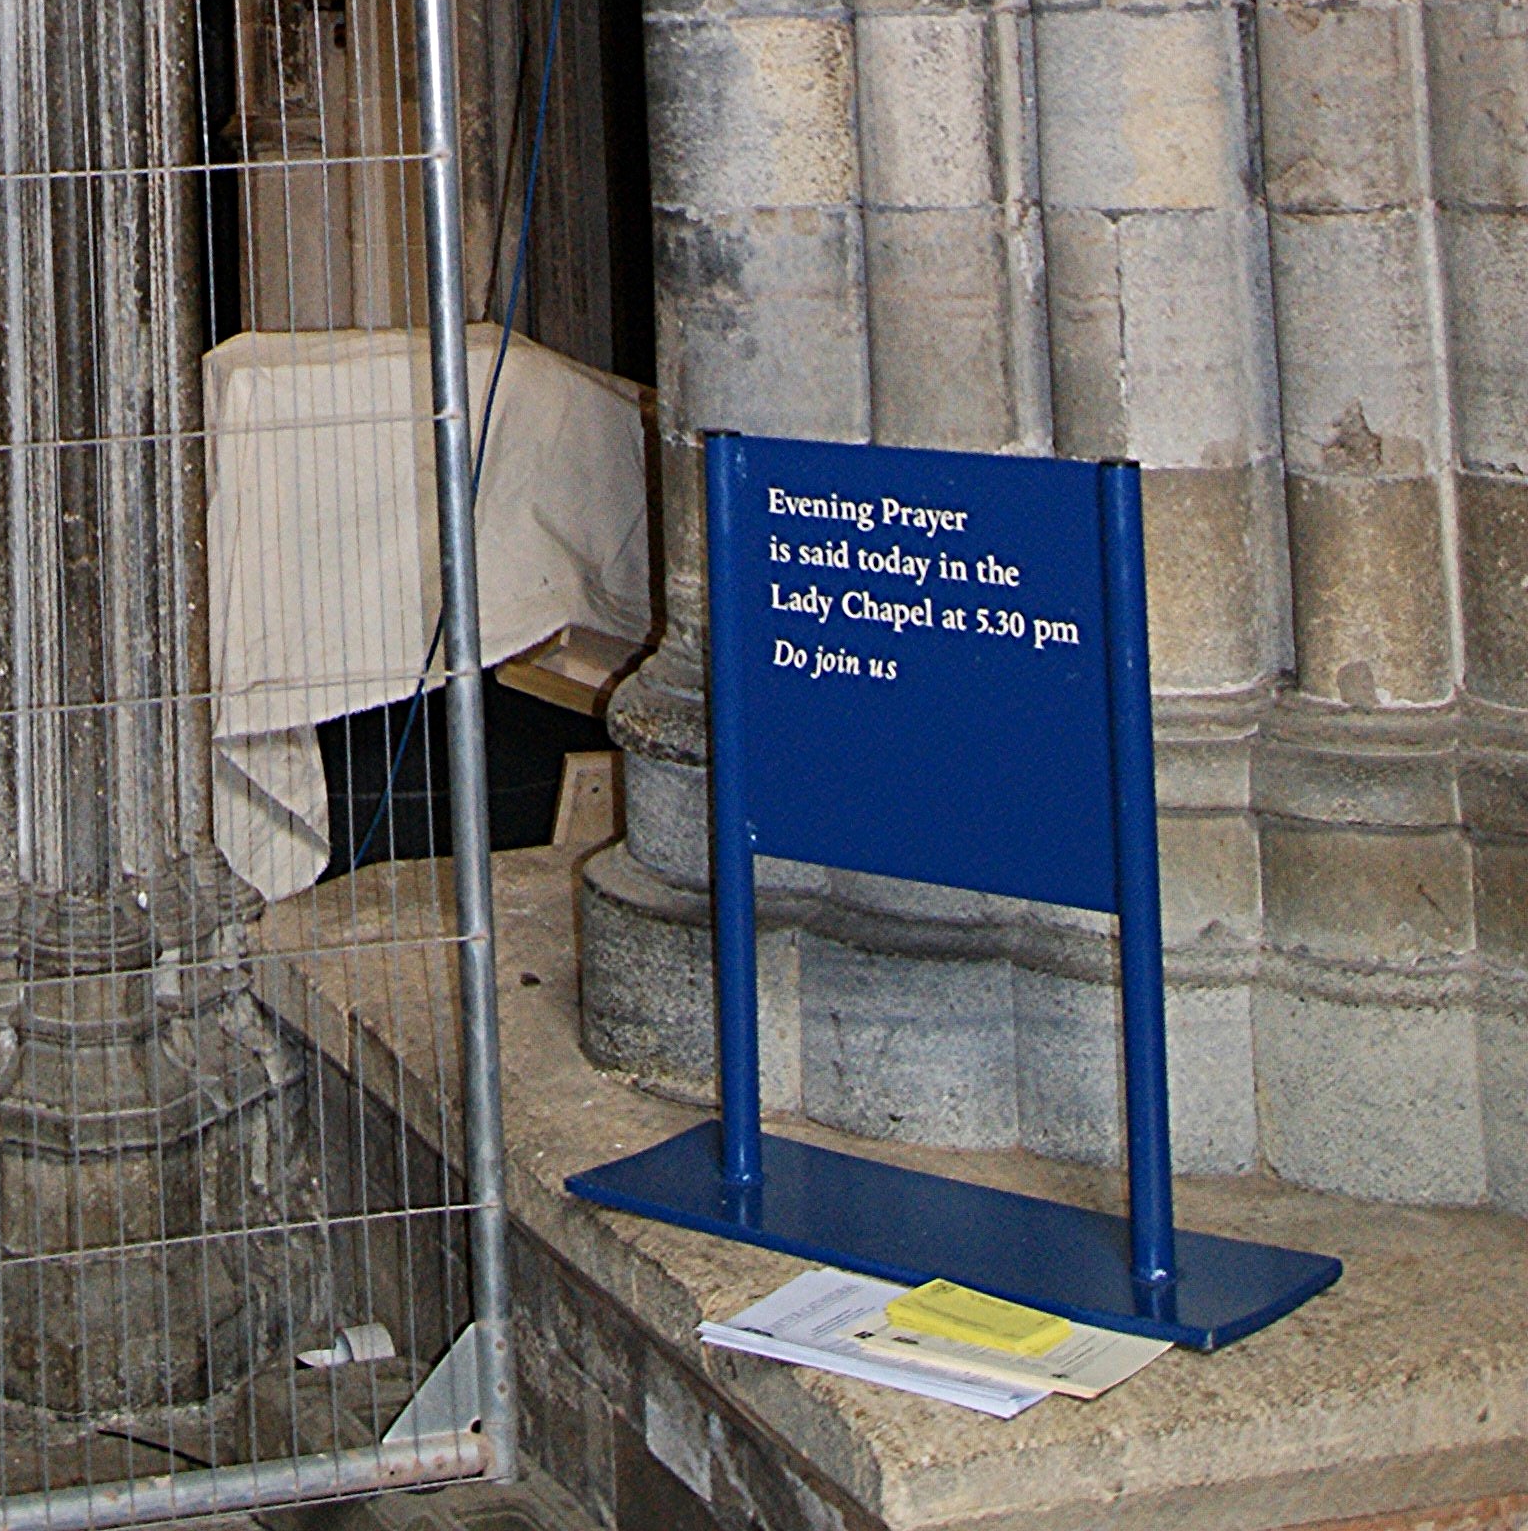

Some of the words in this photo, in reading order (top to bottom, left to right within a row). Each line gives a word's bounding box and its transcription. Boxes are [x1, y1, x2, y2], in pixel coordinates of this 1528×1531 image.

[768, 487, 875, 532] Evening
[881, 497, 968, 538] Prayer
[769, 535, 791, 563] is
[798, 540, 850, 569] said
[857, 545, 931, 586] today
[938, 551, 968, 582] in
[975, 554, 1020, 587] the
[770, 583, 834, 624] Lady
[841, 590, 934, 633] Chapel
[941, 608, 967, 631] at
[976, 608, 1026, 638] 5.30
[1033, 619, 1080, 650] pm
[773, 639, 808, 669] Do
[810, 645, 861, 680] join
[868, 658, 897, 680] us
